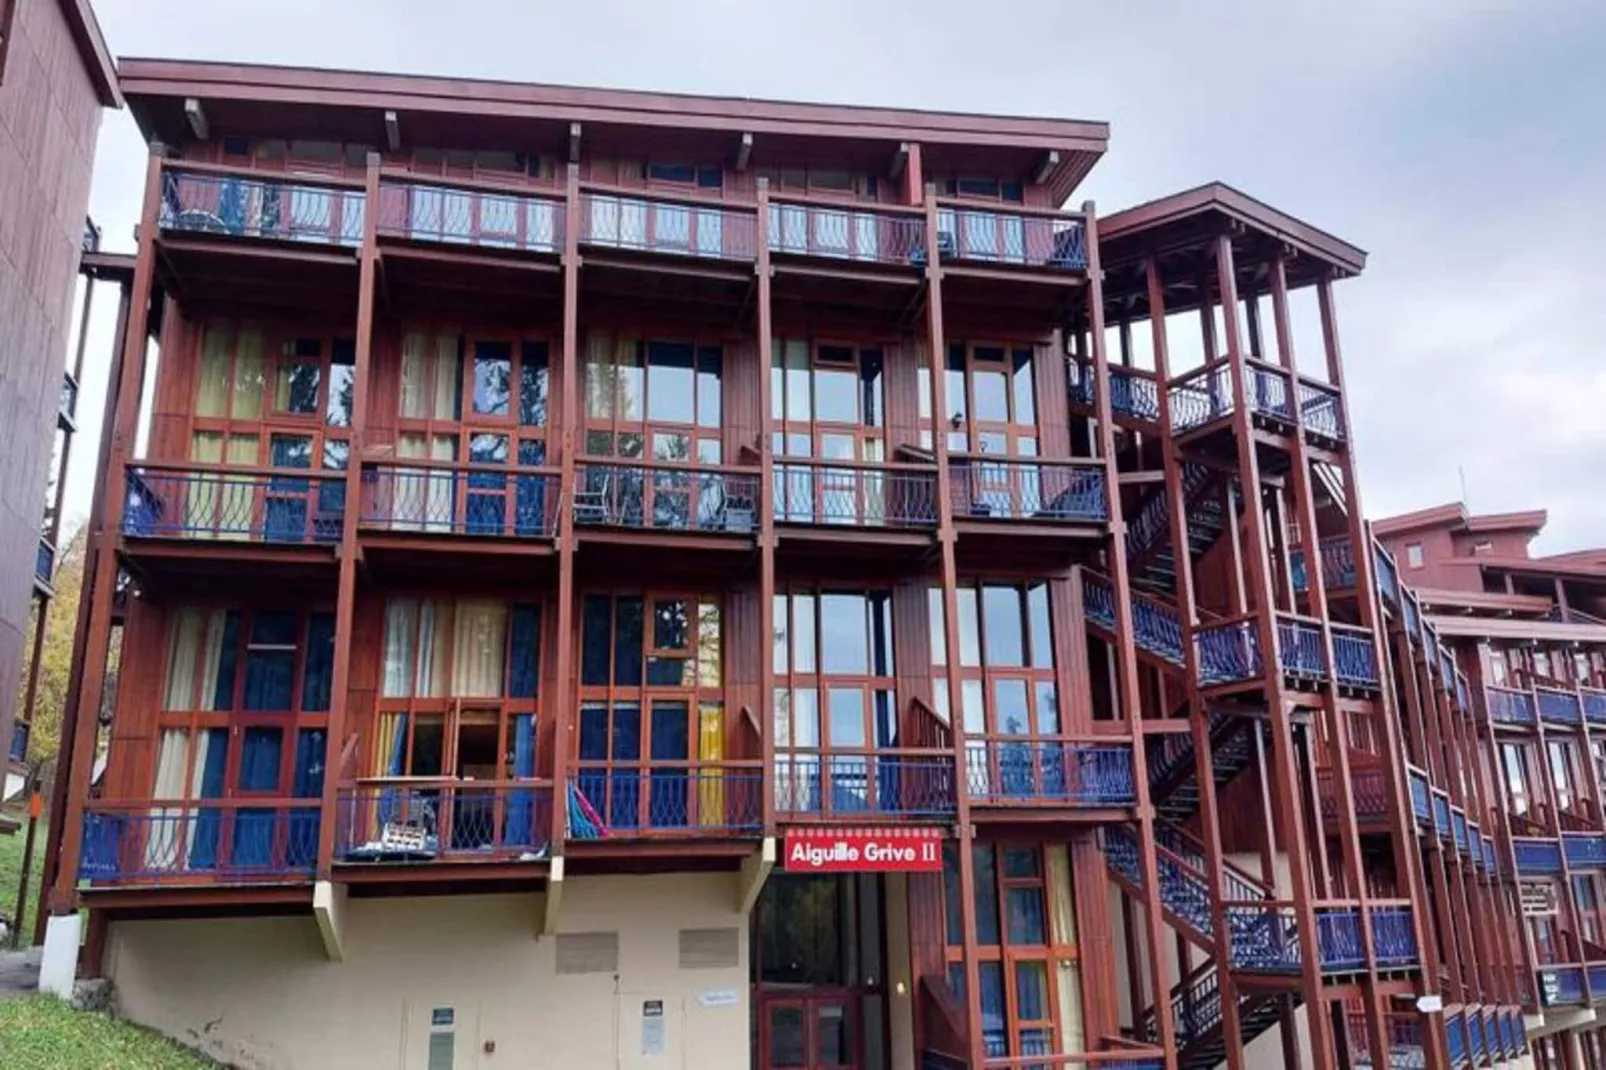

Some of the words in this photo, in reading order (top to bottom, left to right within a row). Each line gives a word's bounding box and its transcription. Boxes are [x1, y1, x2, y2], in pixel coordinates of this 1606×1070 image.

[791, 842, 859, 866] Aiguille
[864, 843, 916, 861] Grive
[922, 843, 936, 861] II
